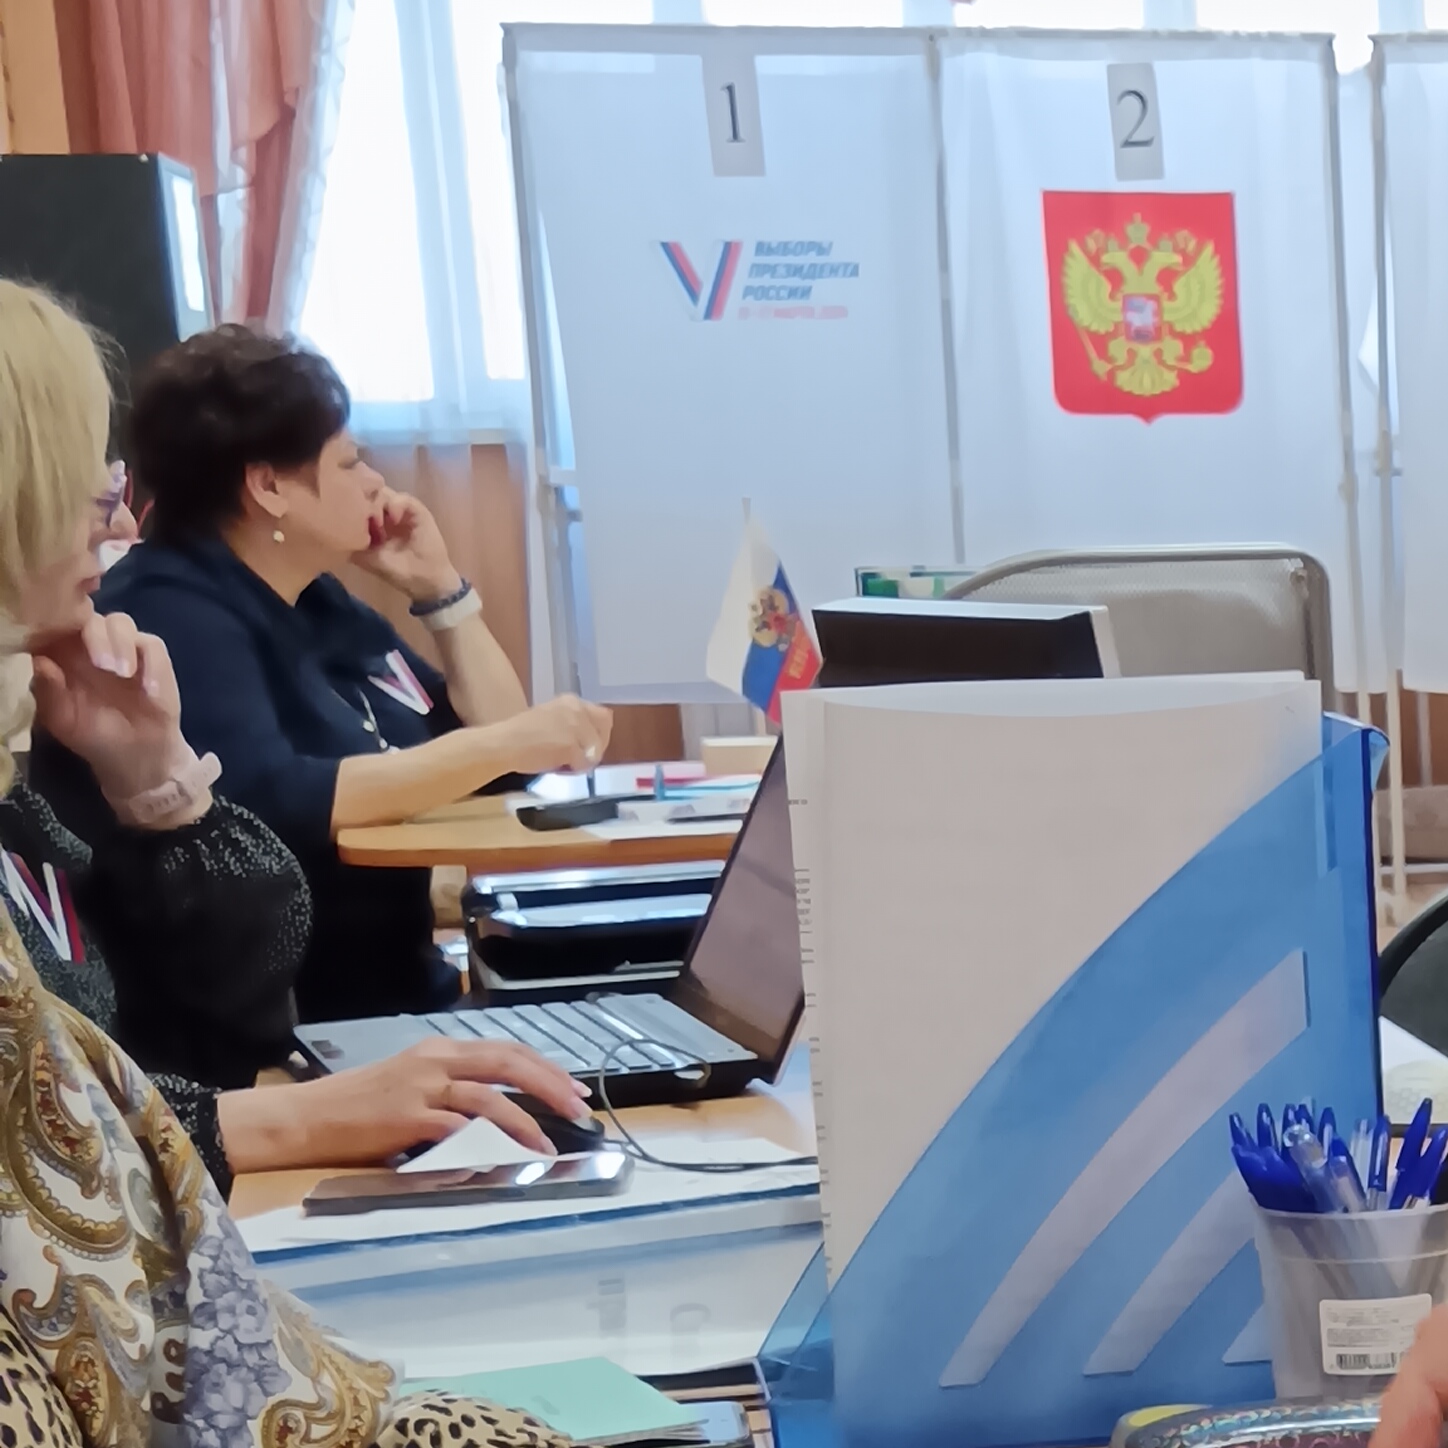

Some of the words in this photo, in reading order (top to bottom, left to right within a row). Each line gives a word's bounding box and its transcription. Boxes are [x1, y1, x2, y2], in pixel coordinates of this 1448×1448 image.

[720, 82, 746, 144] 1
[1116, 89, 1155, 149] 2
[754, 240, 833, 257] ВЫБОРЫ
[748, 262, 860, 280] ПРЕЗИДЕНТА
[742, 285, 812, 300] РОССИИ
